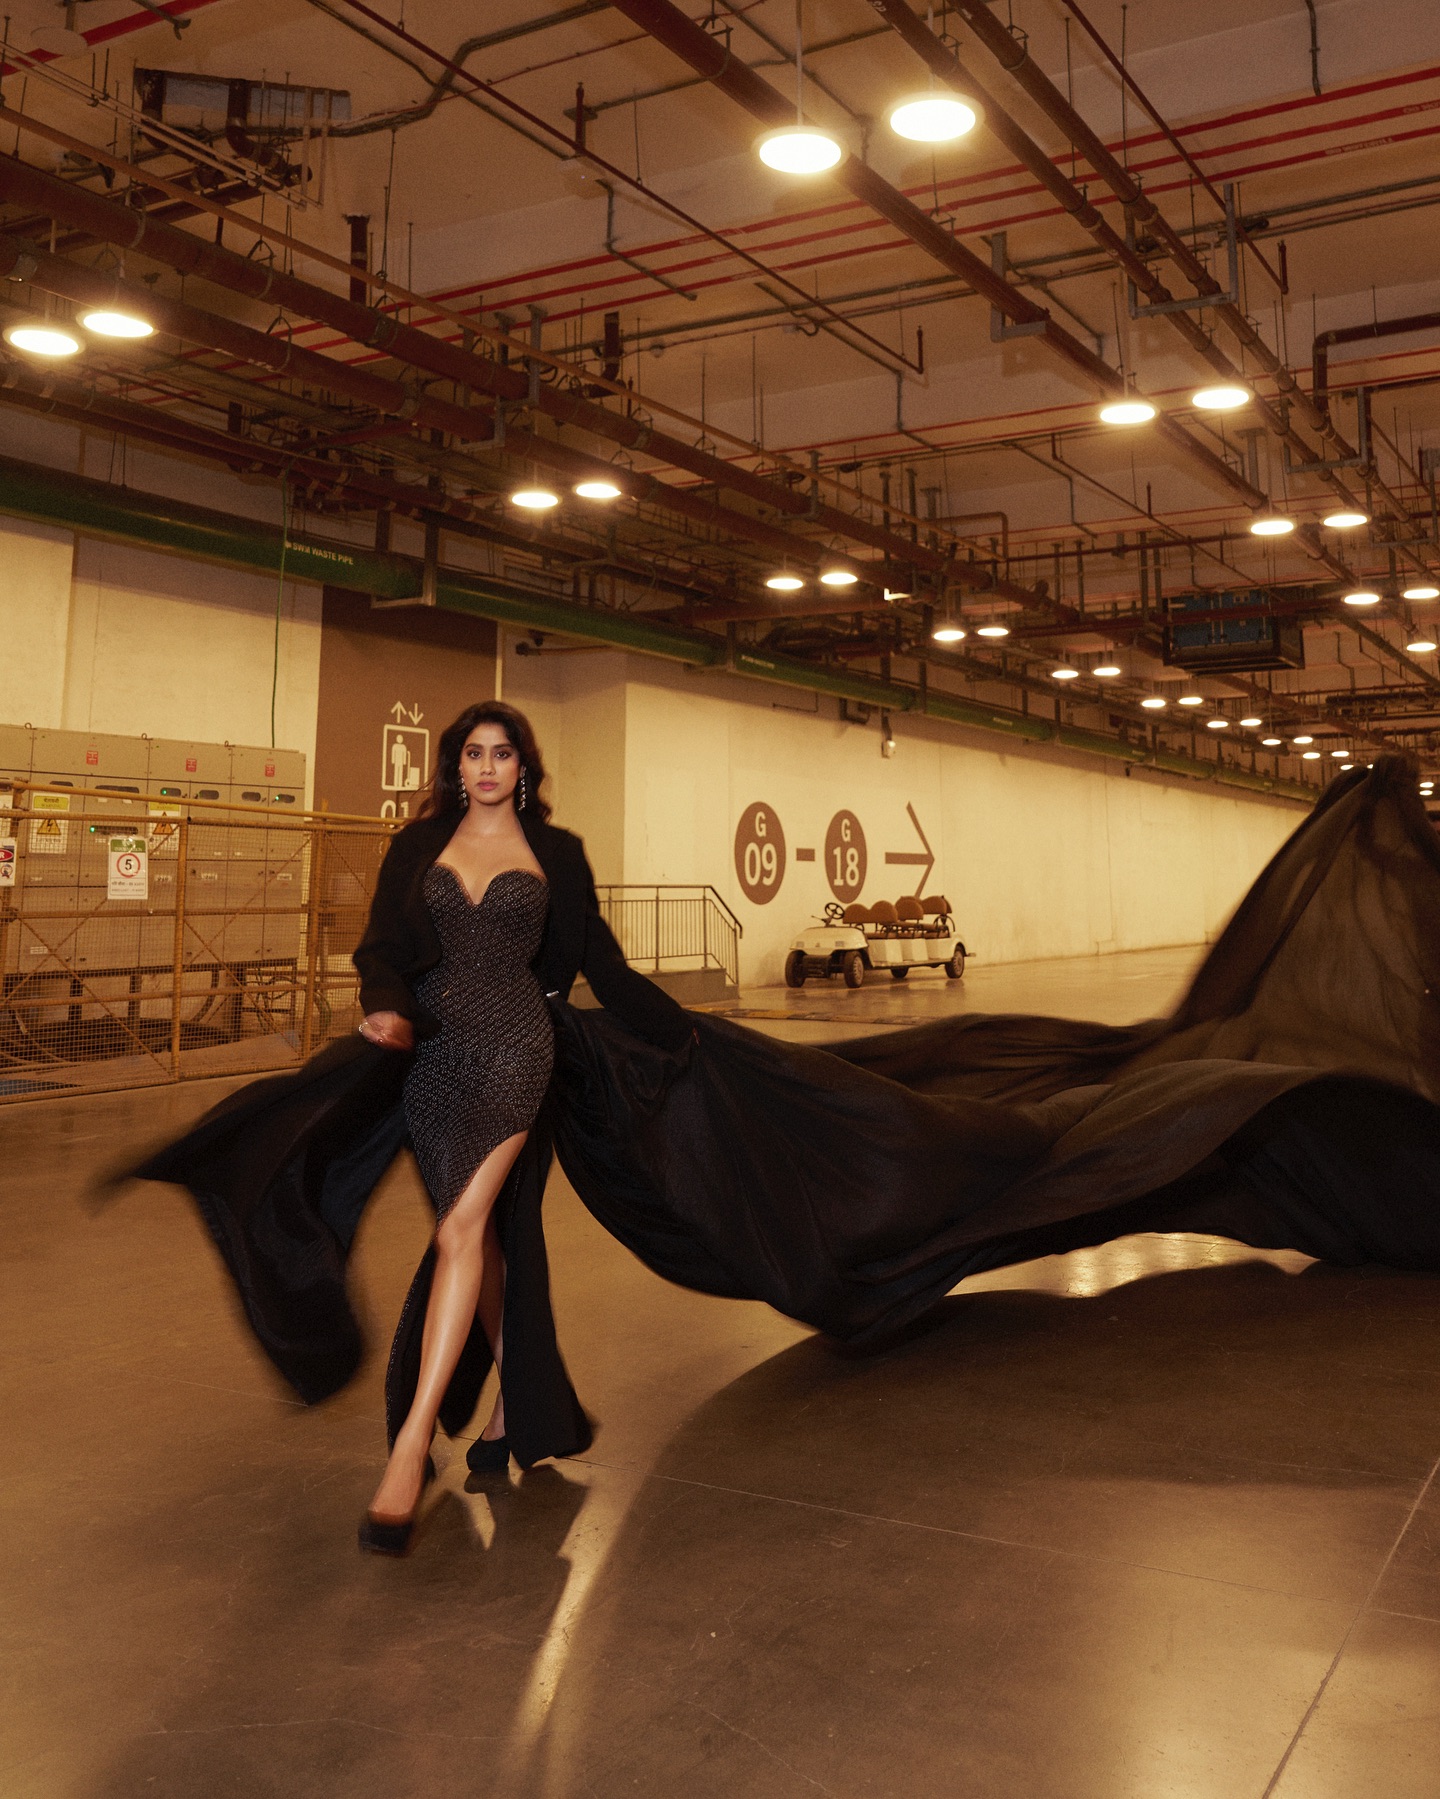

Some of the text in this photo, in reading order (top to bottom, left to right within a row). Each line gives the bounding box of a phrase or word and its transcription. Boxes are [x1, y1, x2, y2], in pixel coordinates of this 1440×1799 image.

[312, 547, 336, 561] WASTE
[338, 554, 354, 565] PIPE
[755, 811, 766, 837] G
[841, 818, 851, 842] G
[124, 858, 132, 870] 5
[744, 842, 777, 886] 09
[833, 847, 859, 887] 18
